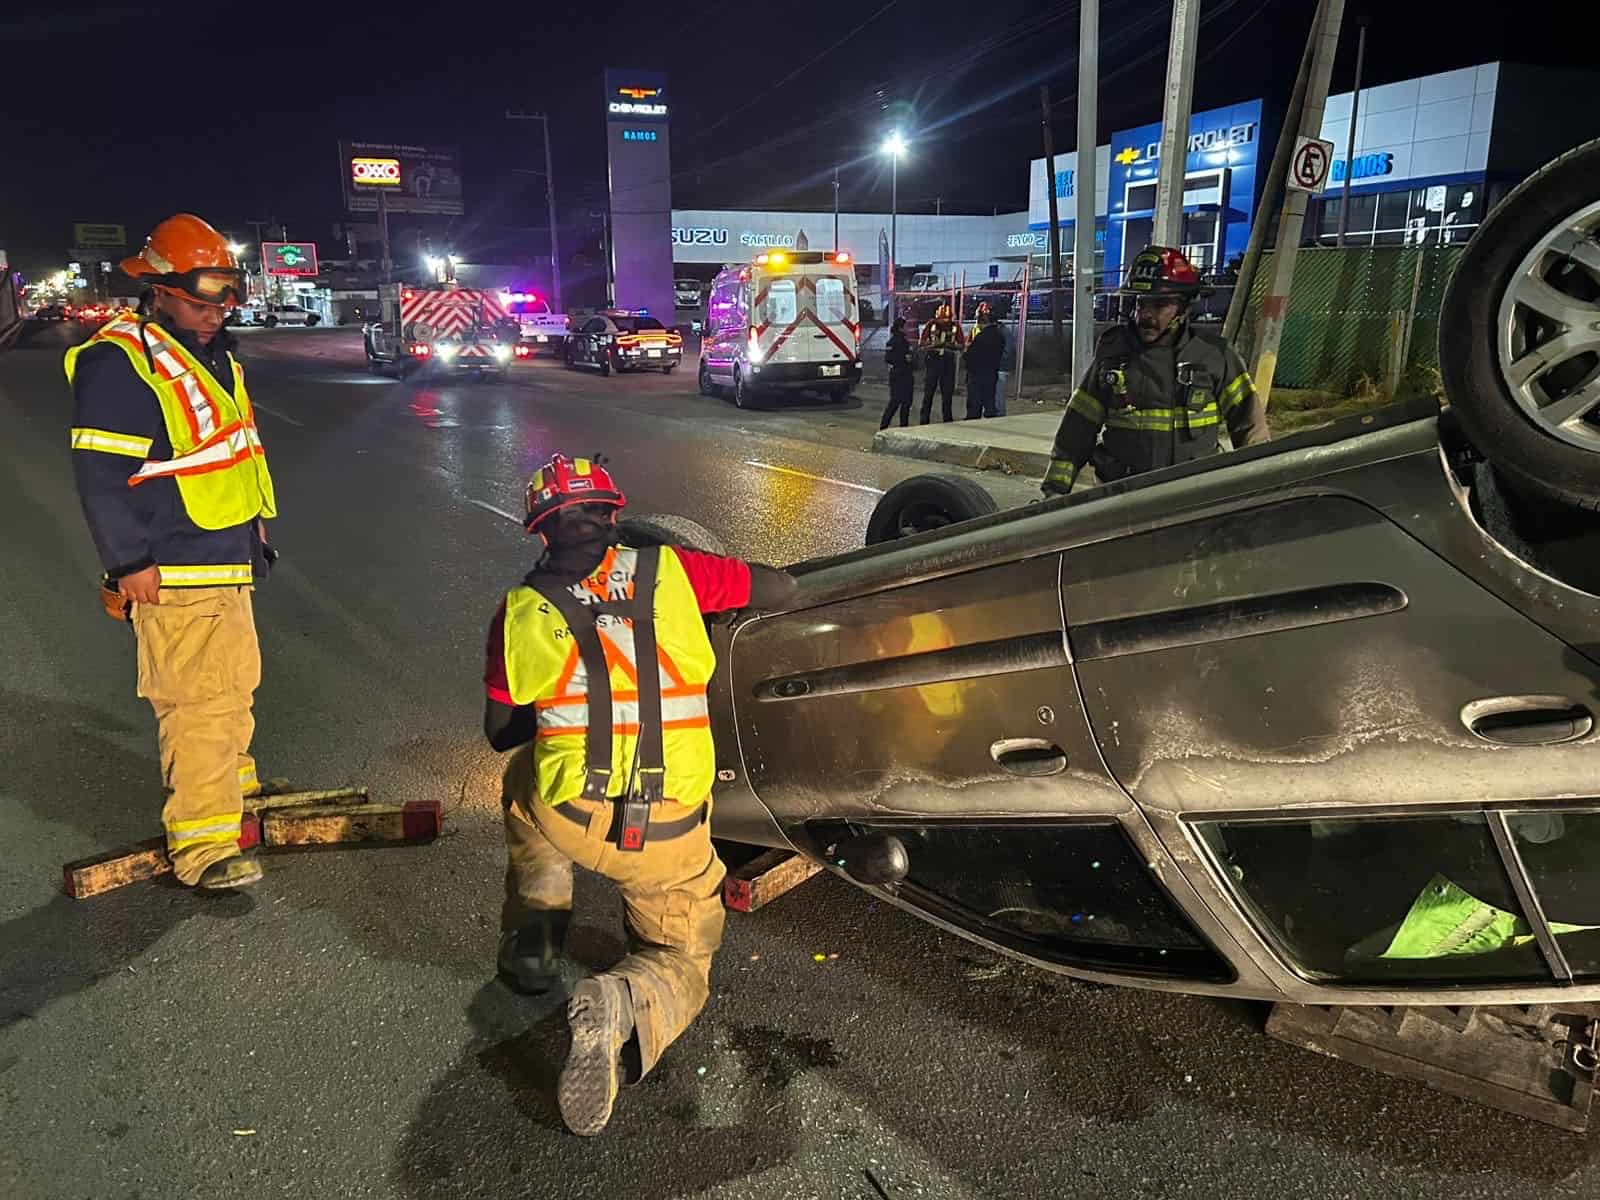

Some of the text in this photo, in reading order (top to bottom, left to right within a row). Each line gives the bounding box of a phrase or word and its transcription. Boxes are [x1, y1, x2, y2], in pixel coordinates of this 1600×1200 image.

[623, 131, 657, 140] RAMOS
[1146, 122, 1257, 160] CROLET
[353, 163, 400, 178] OXXO
[1332, 152, 1391, 181] RMOS
[671, 228, 728, 245] SUZU
